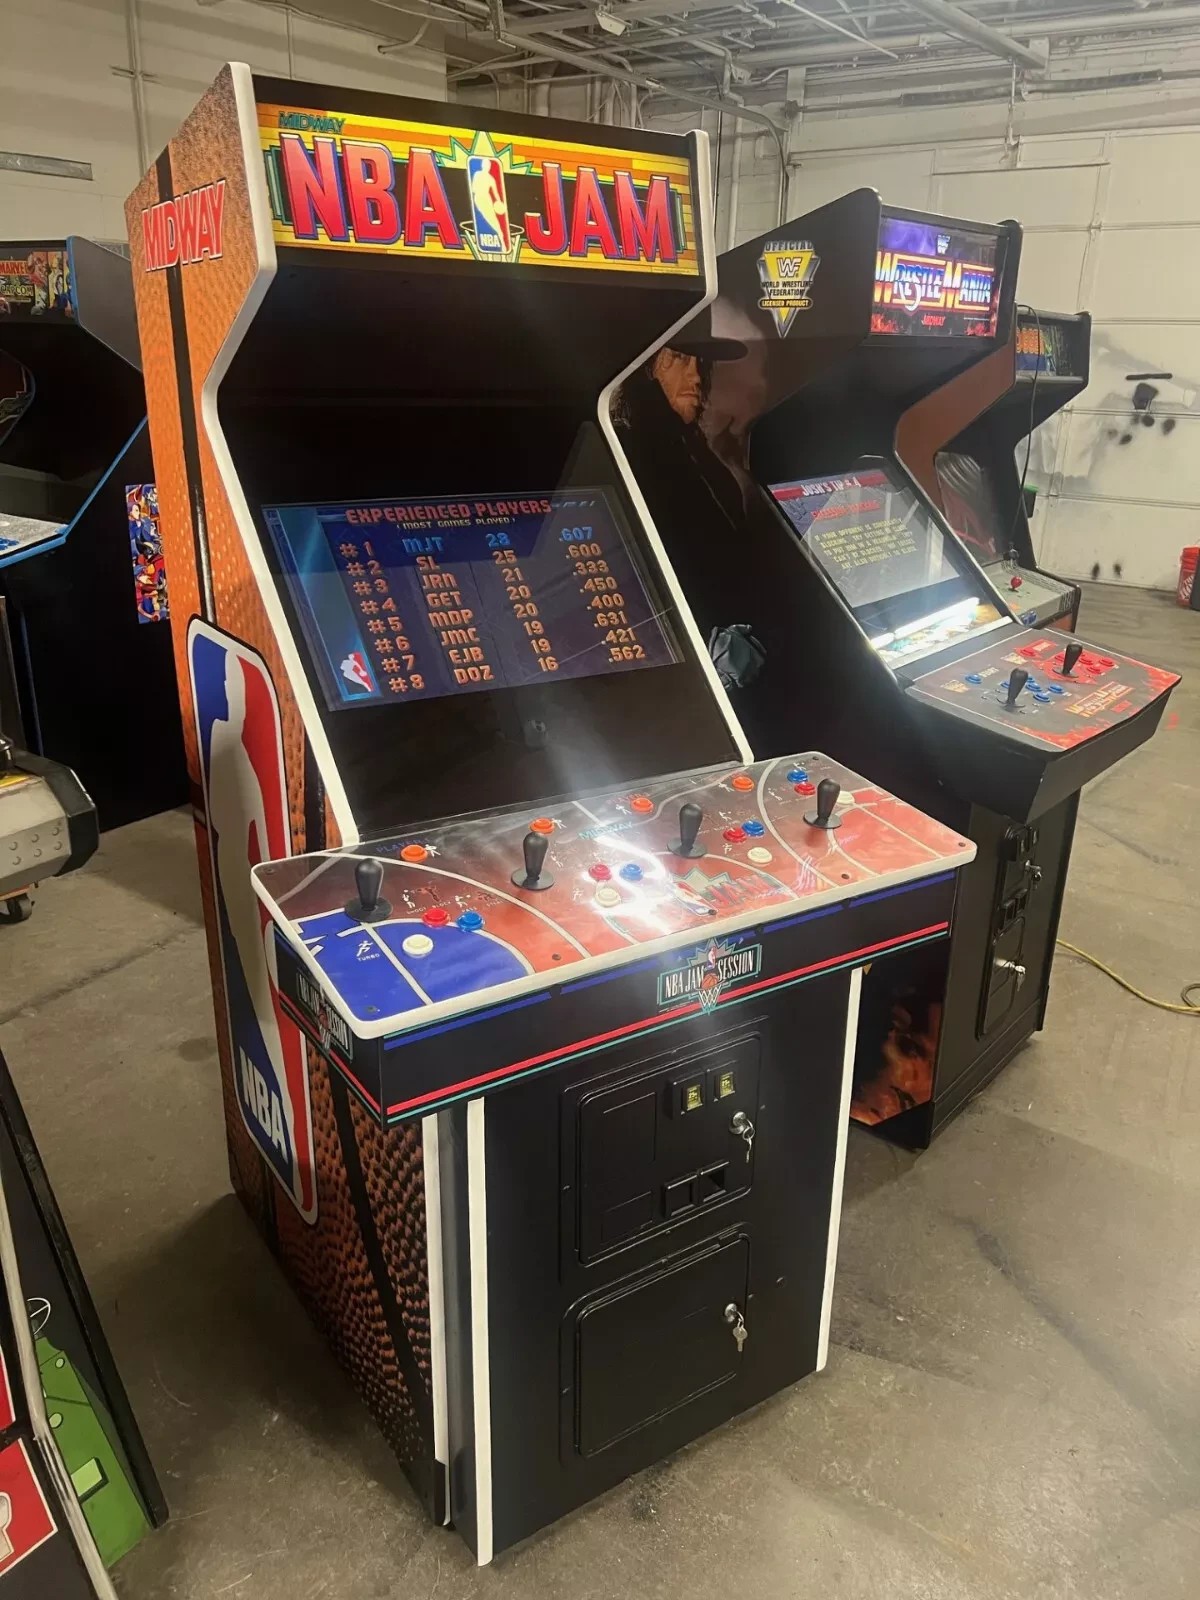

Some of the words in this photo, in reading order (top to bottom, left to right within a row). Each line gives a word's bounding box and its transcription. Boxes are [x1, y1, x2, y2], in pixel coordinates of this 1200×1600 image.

[279, 112, 346, 134] MIDWAY
[279, 132, 465, 250] NBA
[524, 161, 678, 263] JAM
[142, 178, 226, 272] MIDWAY
[480, 233, 501, 247] NBA
[769, 288, 805, 296] FEDERATION
[345, 503, 472, 524] EXPERIENCED
[474, 500, 552, 517] PLAYERS
[437, 519, 472, 528] GAMES
[402, 537, 444, 553] MJT
[485, 532, 511, 548] 28
[558, 526, 593, 542] .607
[416, 555, 440, 571] SL
[492, 549, 518, 565] 25
[565, 543, 602, 559] .600
[422, 573, 457, 590] JRN
[502, 567, 524, 582] 21
[573, 560, 610, 576] .333
[426, 591, 463, 608] GET
[506, 585, 532, 600] 20
[580, 576, 618, 593] .450
[428, 609, 473, 628] MDP
[513, 602, 539, 619] 20
[586, 593, 625, 610] .400
[440, 627, 480, 646] JMC
[523, 620, 544, 636] 19
[593, 610, 628, 628] .631
[448, 646, 485, 664] EJB
[531, 638, 552, 654] 19
[600, 627, 637, 645] .421
[453, 665, 495, 684] DOZ
[538, 656, 559, 672] 16
[608, 644, 647, 663] .562
[665, 972, 684, 998] NBA
[685, 965, 704, 992] JAM
[717, 950, 755, 982] SESSION
[239, 1045, 288, 1164] NBA
